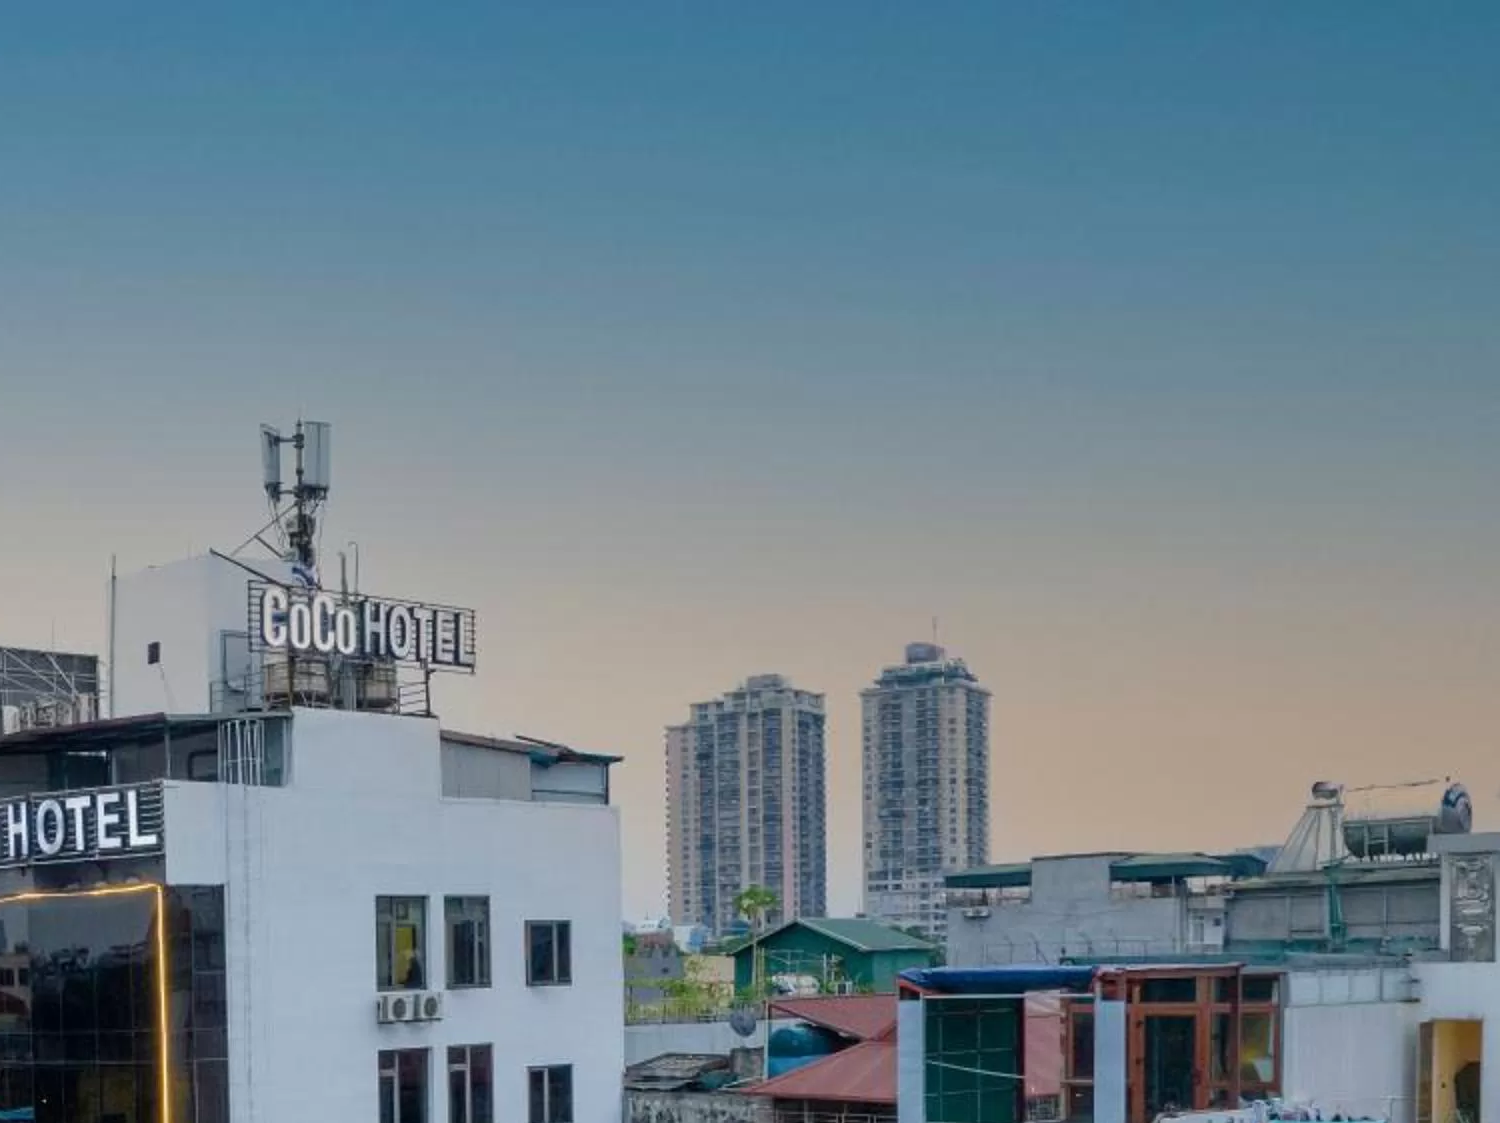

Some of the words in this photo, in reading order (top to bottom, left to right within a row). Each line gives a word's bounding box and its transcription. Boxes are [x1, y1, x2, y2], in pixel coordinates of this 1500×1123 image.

[263, 587, 357, 655] CoCo
[362, 601, 474, 665] HOTEL
[7, 790, 157, 855] HOTEL
